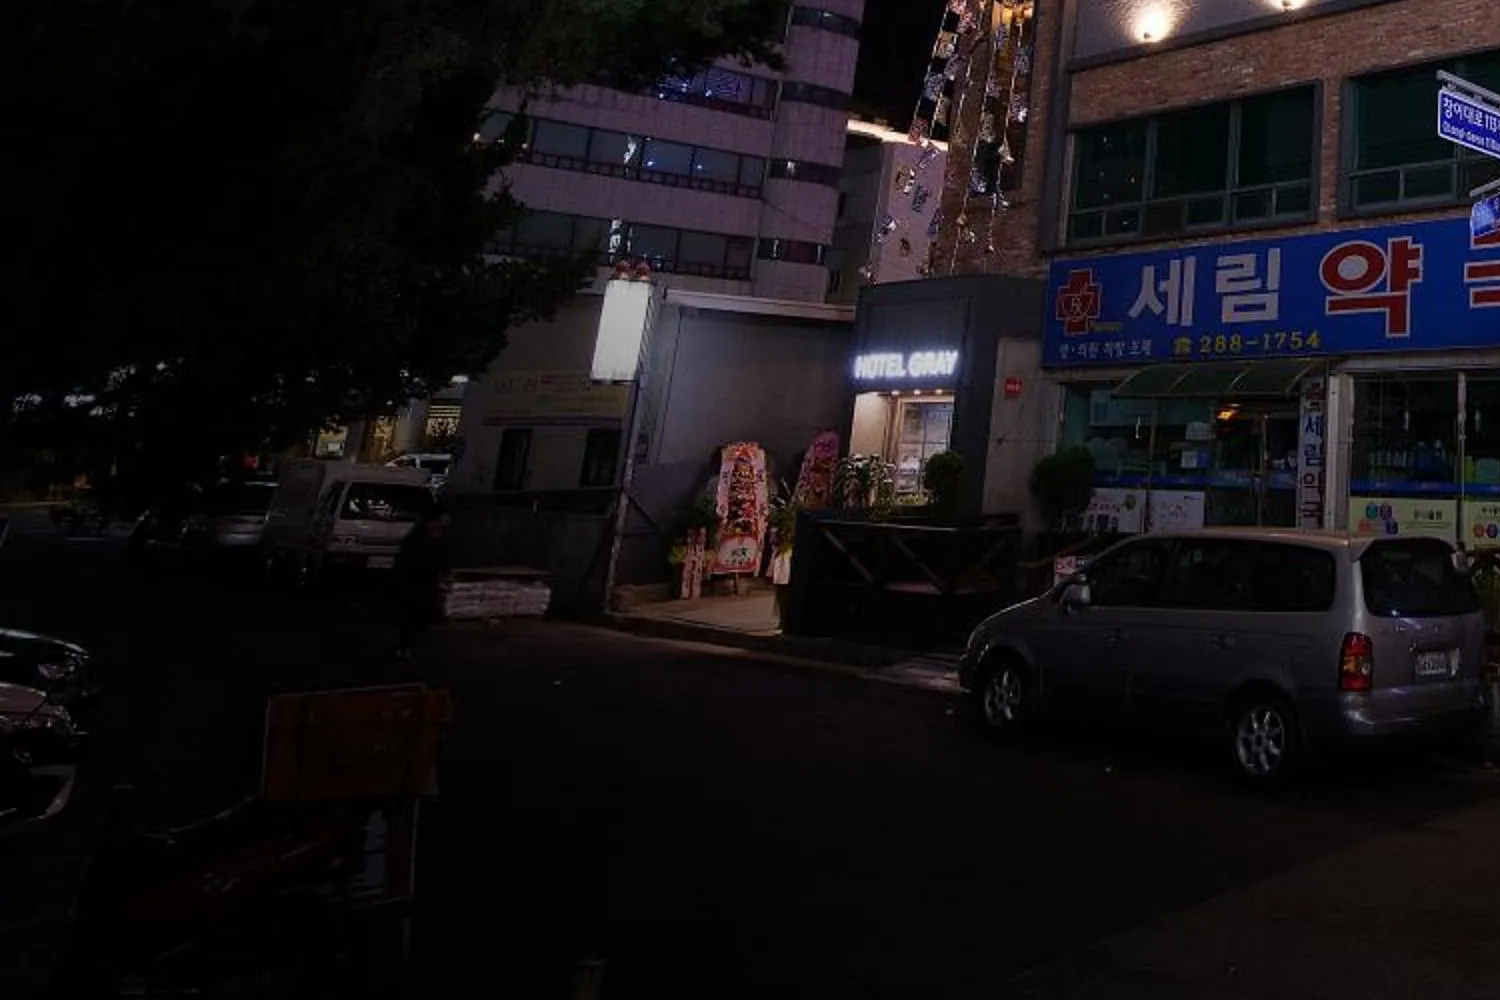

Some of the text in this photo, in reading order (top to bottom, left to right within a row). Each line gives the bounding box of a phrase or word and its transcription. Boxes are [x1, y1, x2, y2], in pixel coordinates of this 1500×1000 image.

[1128, 247, 1281, 327] 세림
[1199, 330, 1321, 355] 288-1754
[854, 350, 960, 379] HOTEL GRAY
